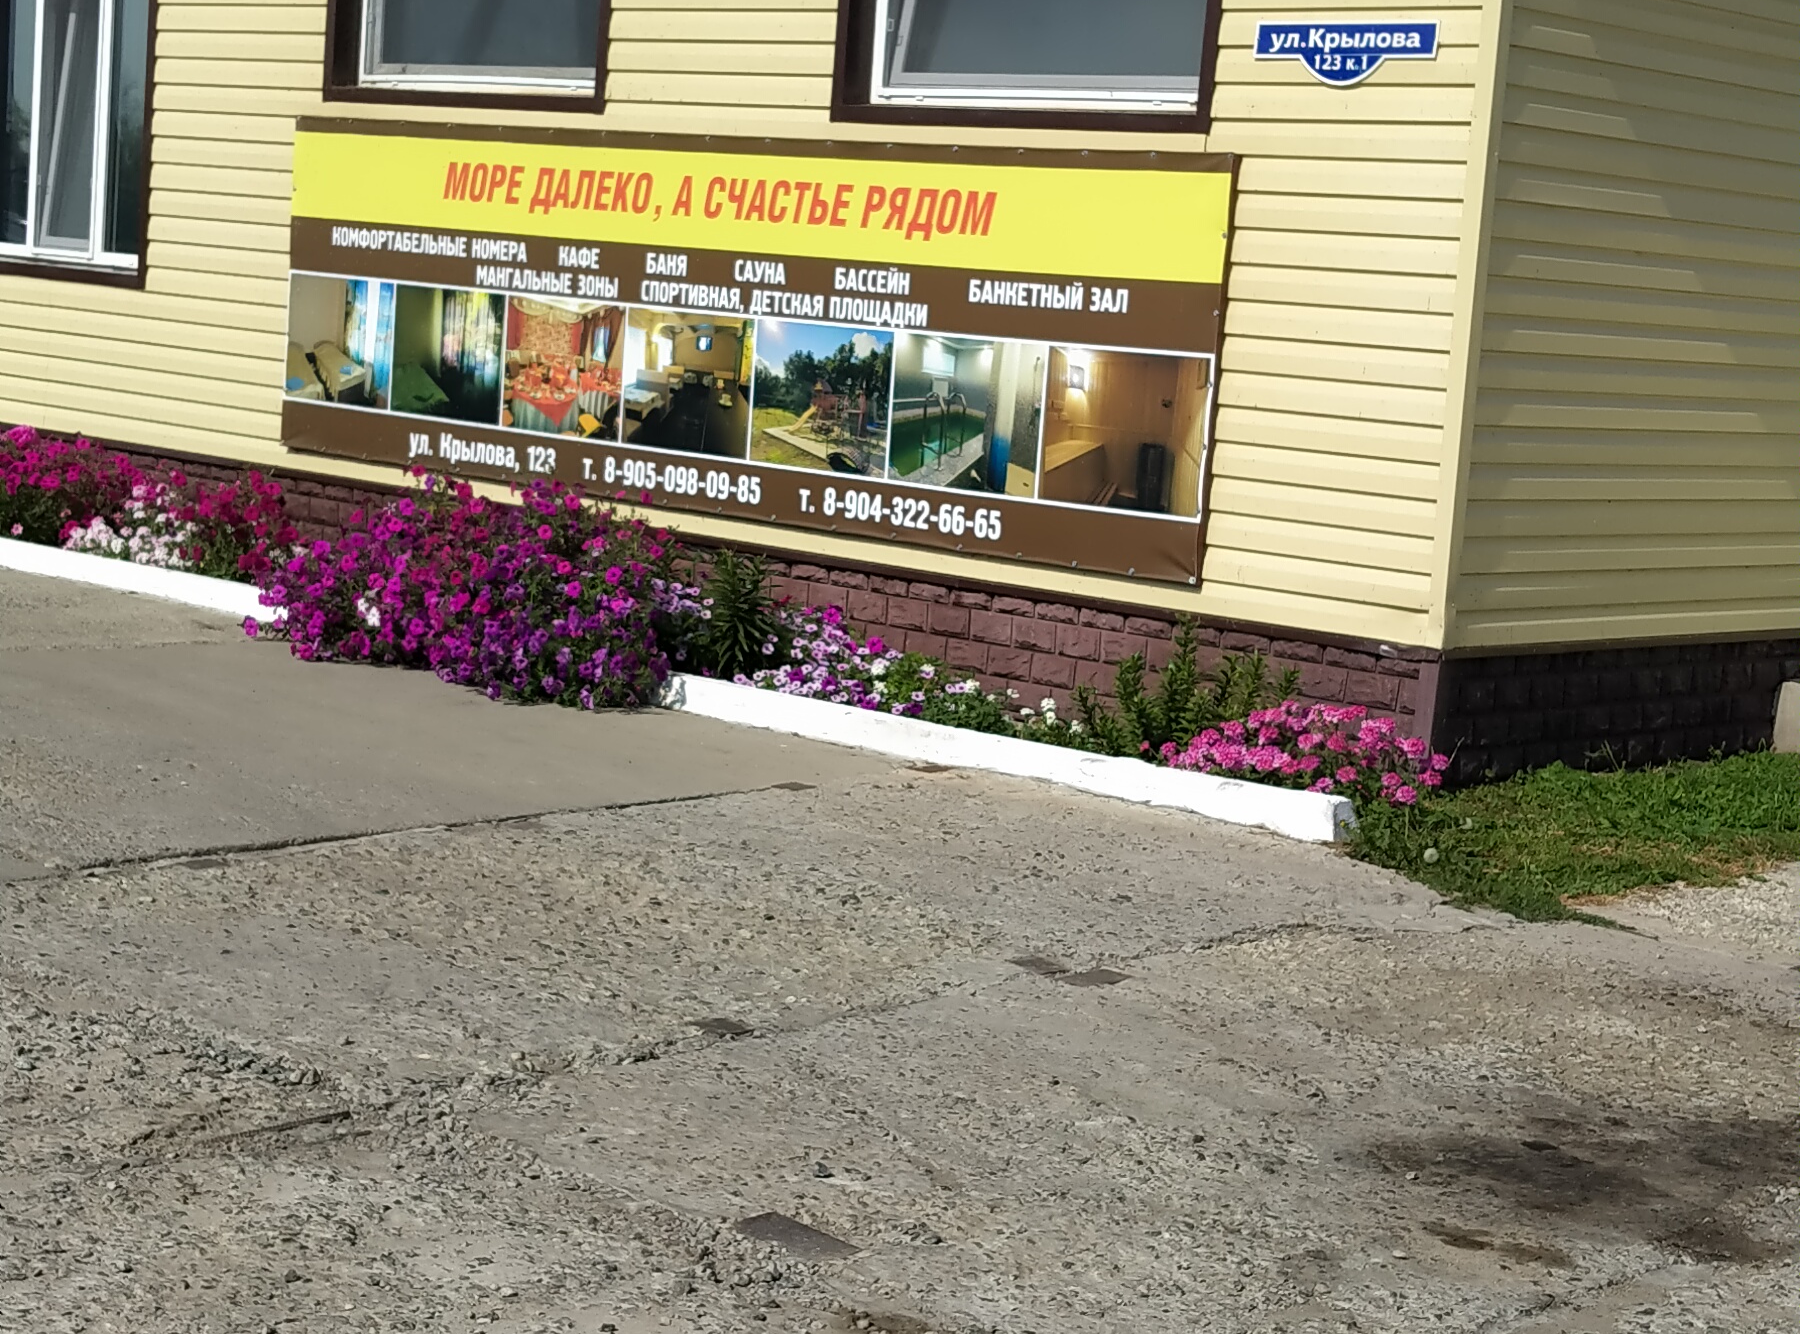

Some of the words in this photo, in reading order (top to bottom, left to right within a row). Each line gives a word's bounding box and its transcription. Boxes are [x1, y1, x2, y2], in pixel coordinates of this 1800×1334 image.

[1269, 28, 1420, 52] ул.Крылова
[1314, 55, 1341, 70] 123
[443, 162, 525, 204] МОРЕ
[529, 168, 662, 221] ДАЛЕКО,
[673, 177, 692, 216] А
[703, 177, 854, 227] СЧАСТЬЕ
[860, 186, 997, 241] РЯДОМ
[332, 227, 467, 257] КОМФОРТАБЕЛЬНЫЕ
[472, 239, 527, 262] НОМЕРА
[559, 247, 600, 269] КАФЕ
[646, 253, 687, 276] БАНЯ
[735, 259, 786, 286] САУНА
[835, 266, 910, 295] БАССЕЙН
[969, 280, 1084, 310] БАНКЕТНЫЙ
[1090, 288, 1128, 313] ЗАЛ
[476, 269, 572, 293] МАНГАЛЬНЫЕ
[578, 277, 618, 298] ЗОНЫ
[641, 280, 745, 314] СПОРТИВНАЯ,
[750, 292, 823, 318] ДЕТСКАЯ
[829, 297, 928, 328] ПЛОЩАДКИ
[409, 432, 433, 458] ул.
[440, 434, 519, 472] Крылова,
[527, 446, 556, 473] 123
[605, 457, 760, 505] 8-905-098-09-85
[824, 487, 1001, 540] 8-904-322-66-65
